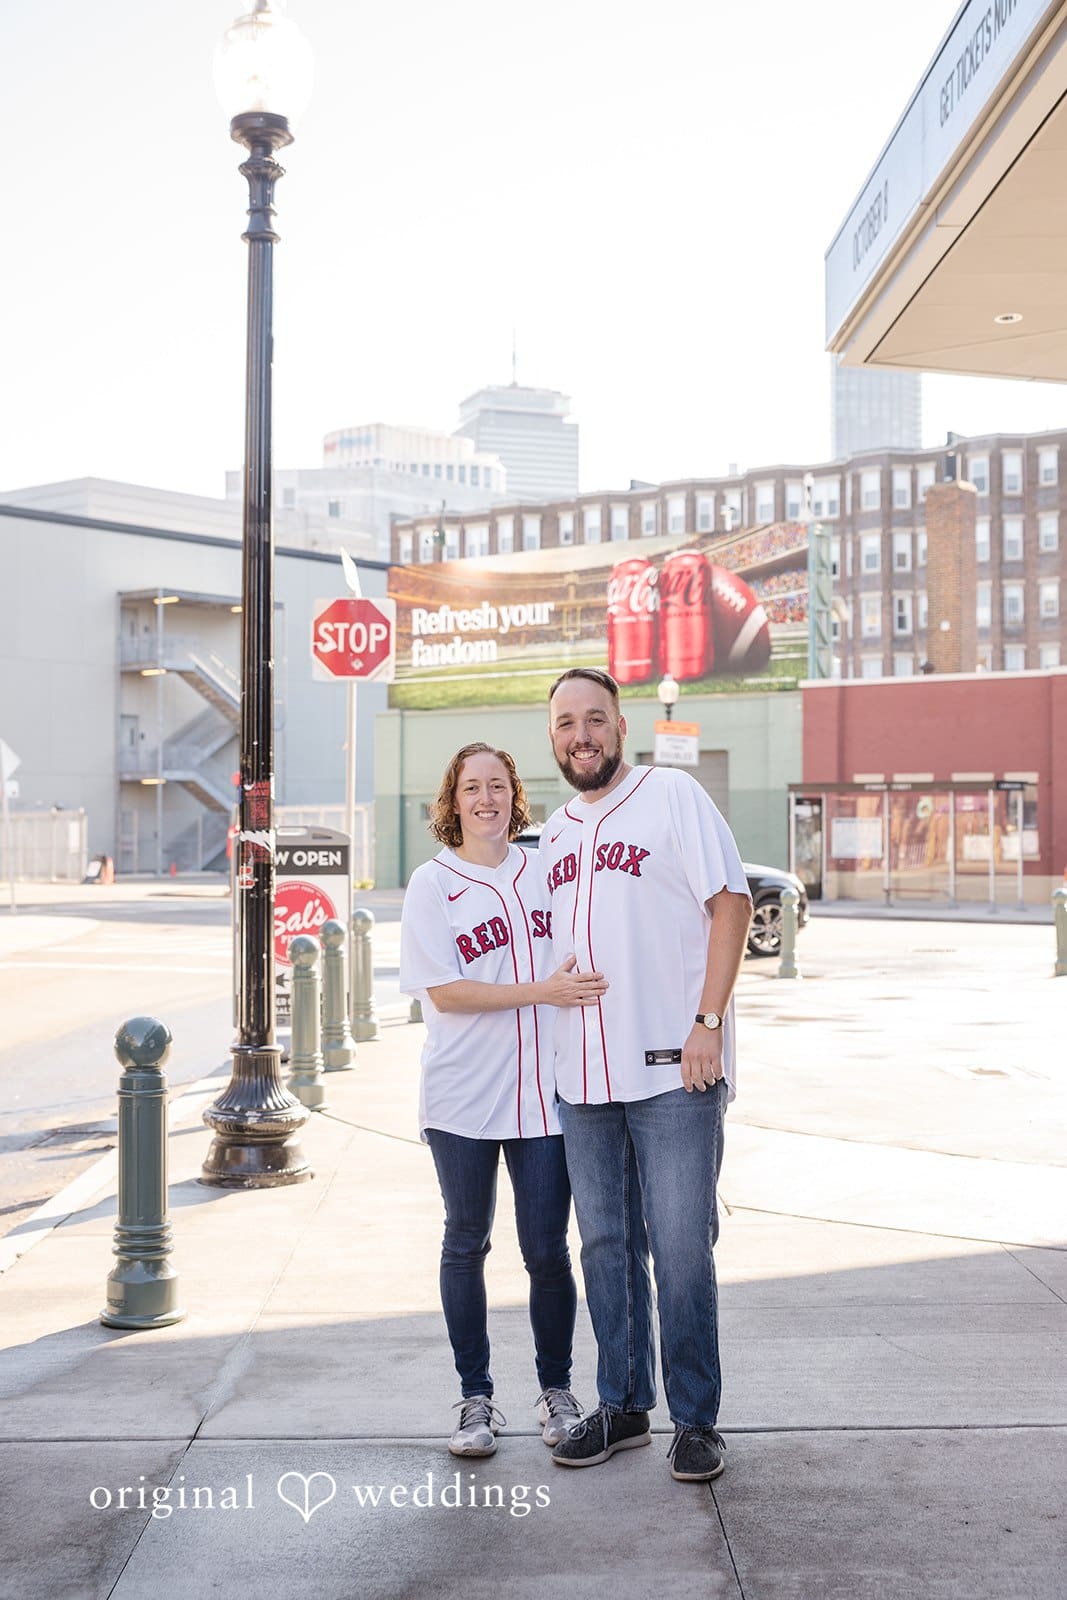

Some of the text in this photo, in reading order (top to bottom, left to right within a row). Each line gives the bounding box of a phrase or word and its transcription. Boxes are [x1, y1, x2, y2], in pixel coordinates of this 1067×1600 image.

[940, 69, 955, 128] GET
[956, 7, 991, 102] TICKETS
[853, 190, 882, 272] OCTOBER
[411, 601, 555, 636] Refresh your
[317, 622, 388, 654] STOP
[411, 636, 497, 667] fandom
[292, 850, 342, 866] OPEN
[595, 841, 651, 877] SOX
[456, 916, 509, 964] RED
